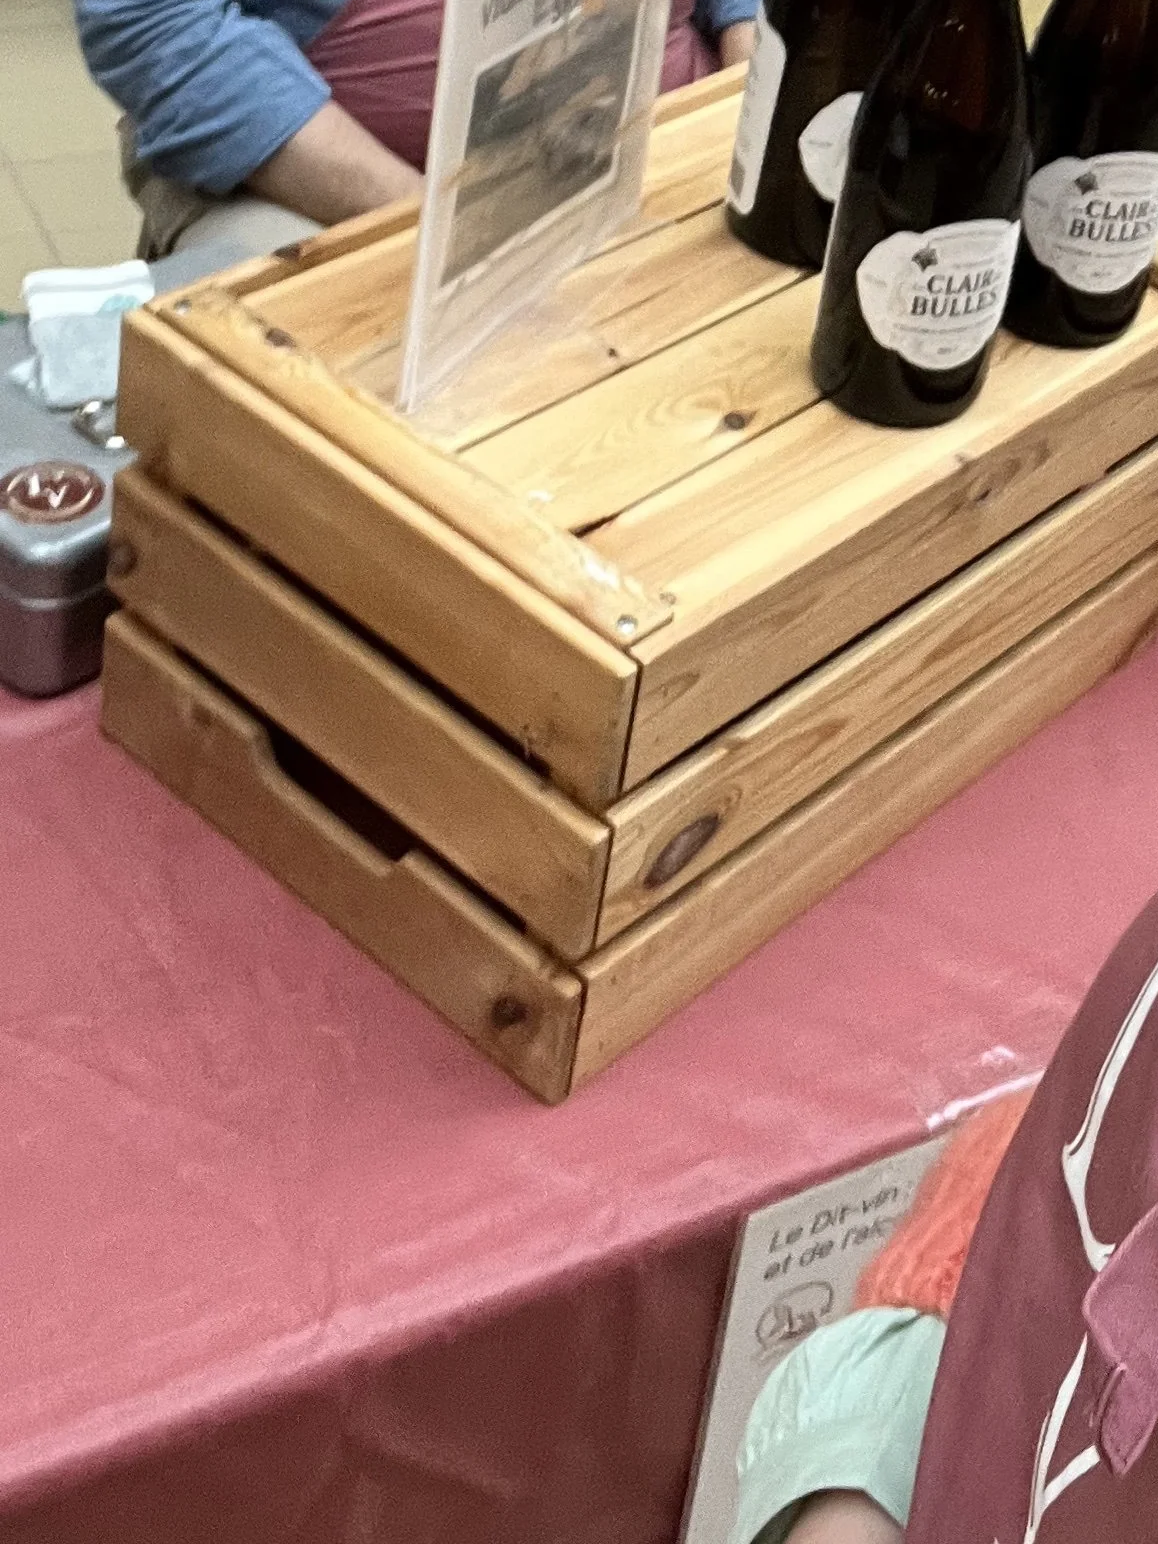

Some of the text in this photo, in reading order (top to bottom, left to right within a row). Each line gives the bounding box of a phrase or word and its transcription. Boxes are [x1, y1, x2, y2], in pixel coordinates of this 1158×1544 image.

[1086, 200, 1150, 221] CLAIR
[1069, 219, 1154, 242] BULLES
[927, 270, 994, 295] CLAIR
[911, 291, 997, 318] BULLES
[769, 1227, 803, 1254] Le
[764, 1240, 835, 1281] et de
